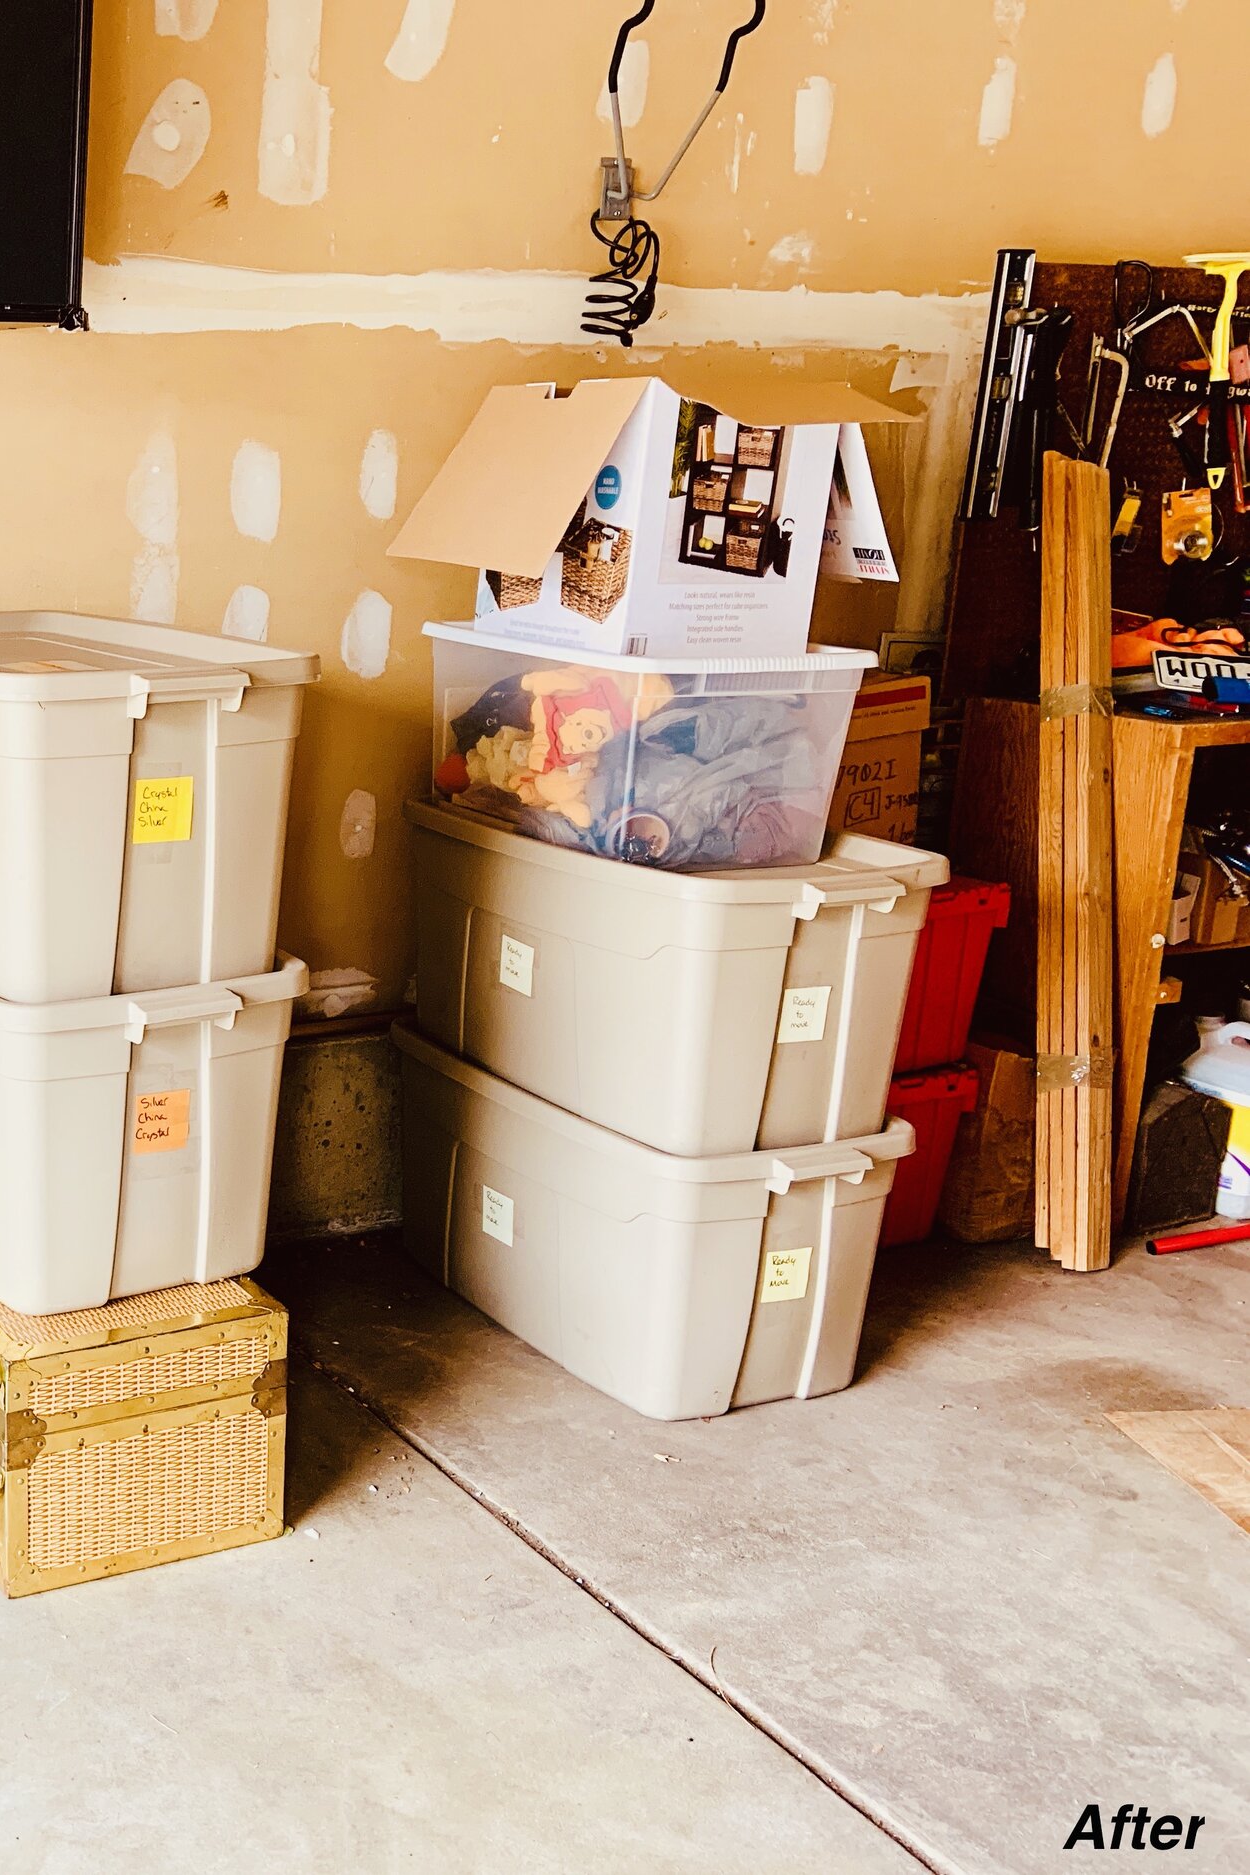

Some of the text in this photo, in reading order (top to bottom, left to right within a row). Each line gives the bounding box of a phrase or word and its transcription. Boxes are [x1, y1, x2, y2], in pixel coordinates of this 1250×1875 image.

[1145, 374, 1177, 391] Off
[1184, 380, 1197, 392] to
[142, 786, 178, 800] Crystal
[139, 801, 169, 814] China
[849, 792, 875, 820] C4
[137, 814, 167, 827] Silver
[792, 995, 816, 1008] Ready
[796, 1010, 804, 1019] to
[140, 1096, 169, 1109] Silver
[137, 1112, 168, 1124] China
[135, 1126, 170, 1142] Crystal
[772, 1255, 797, 1267] Ready
[776, 1268, 784, 1277] to
